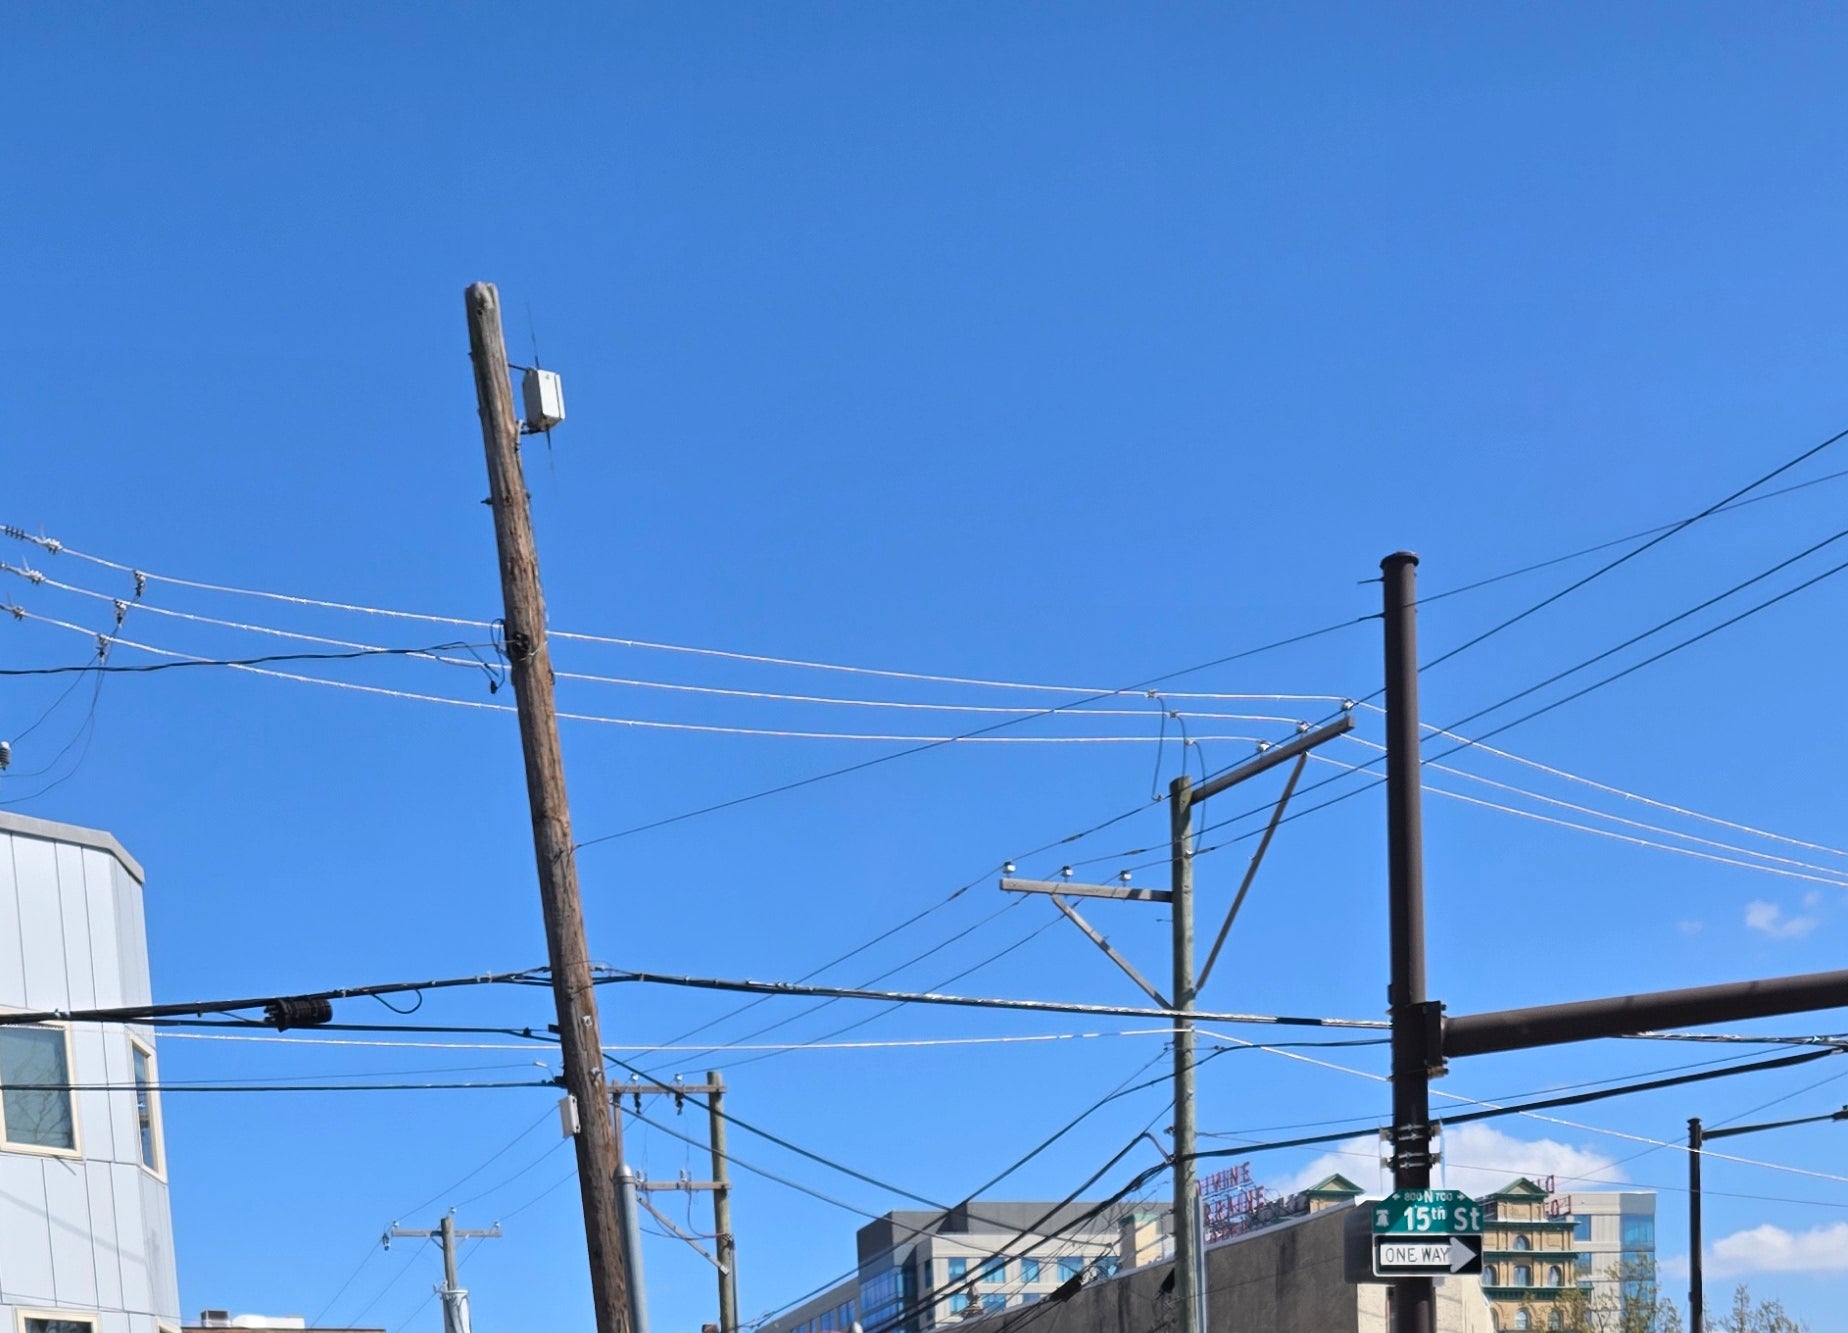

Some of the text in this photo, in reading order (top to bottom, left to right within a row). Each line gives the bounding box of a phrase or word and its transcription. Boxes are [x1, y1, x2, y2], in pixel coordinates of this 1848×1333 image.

[1404, 1190, 1453, 1203] 800 N 700
[1403, 1206, 1480, 1231] 15th St
[1385, 1247, 1450, 1263] ONE WAY
